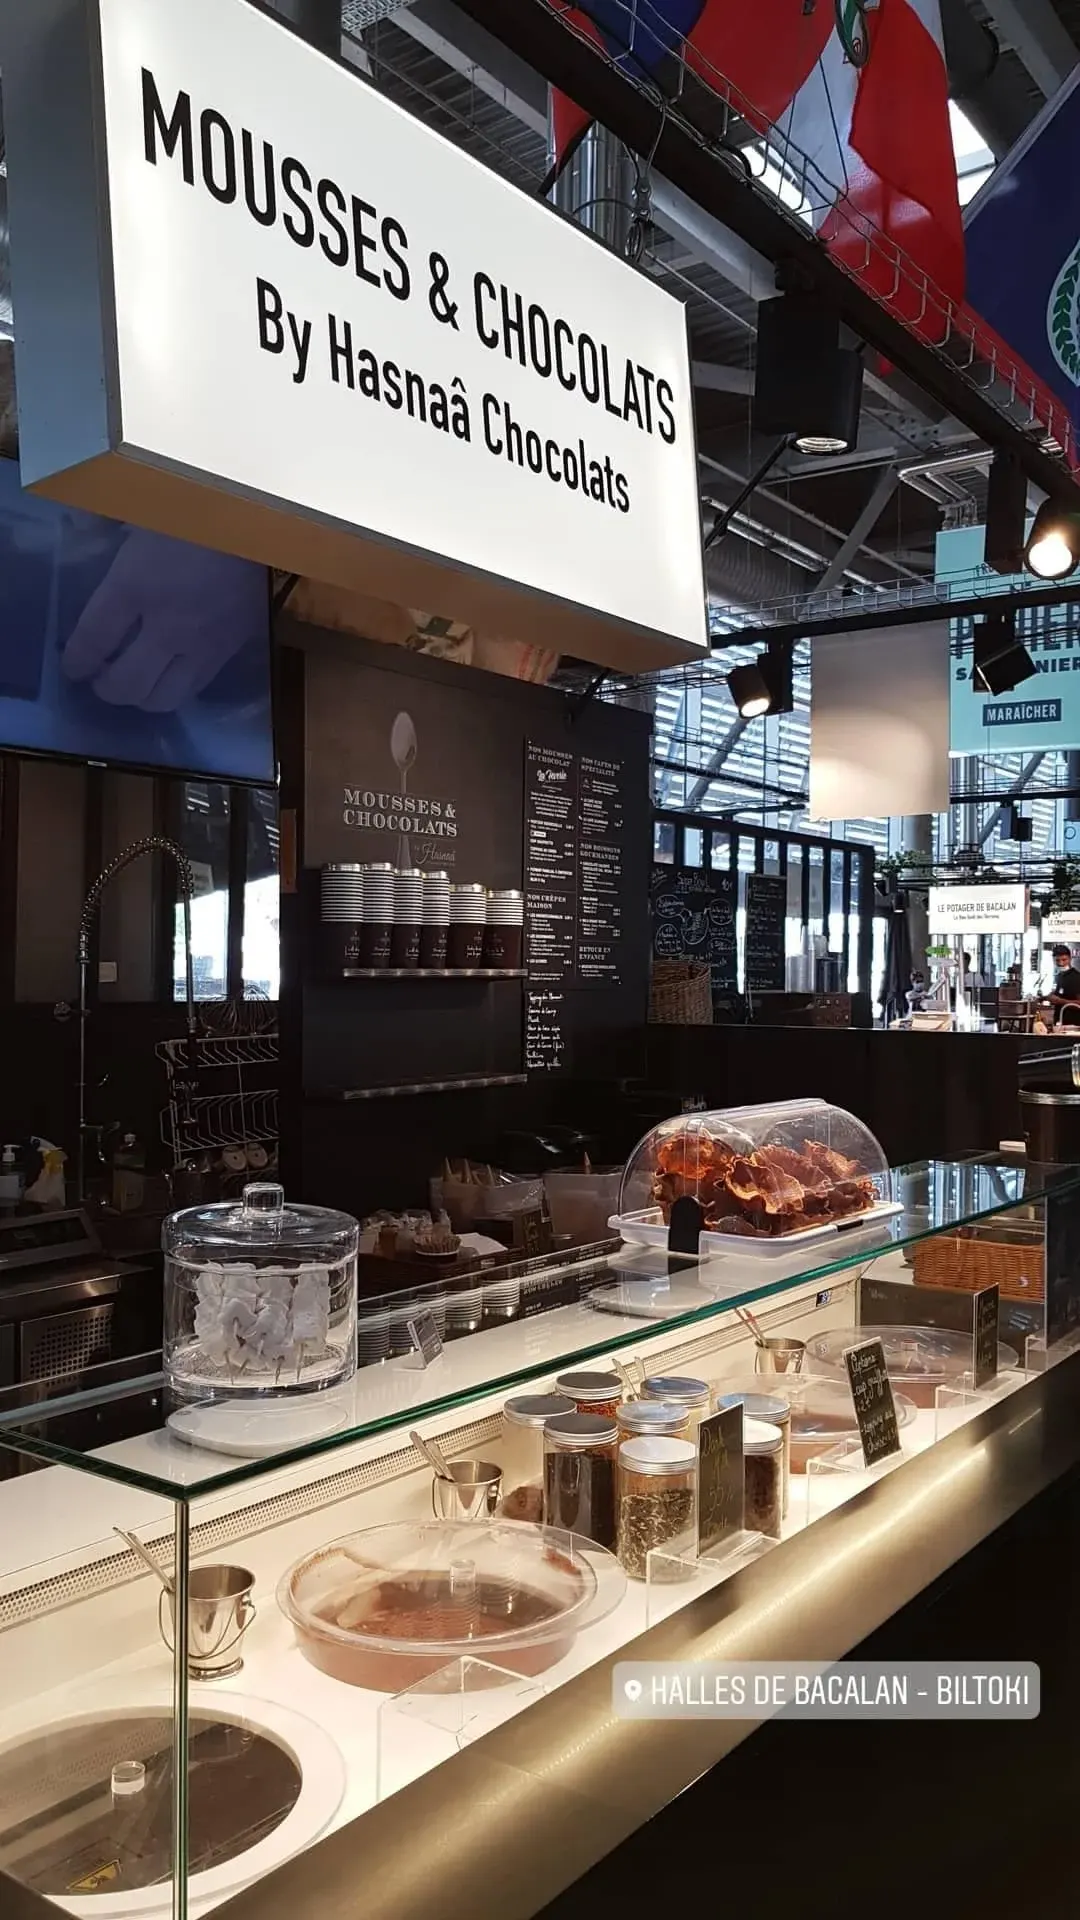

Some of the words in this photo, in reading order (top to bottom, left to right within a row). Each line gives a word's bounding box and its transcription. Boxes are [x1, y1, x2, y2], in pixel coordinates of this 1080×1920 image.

[140, 66, 411, 301] MOUSSES
[428, 252, 460, 330] &
[473, 271, 676, 444] CHOCOLATS
[256, 277, 312, 384] By
[328, 313, 471, 442] Hasnaâ
[482, 391, 630, 514] Chocolats
[343, 788, 441, 817] MOUSSES
[445, 803, 457, 819] &
[343, 809, 458, 838] CHOCOLATS
[937, 904, 946, 913] LE
[947, 903, 975, 912] POTAGER
[976, 903, 985, 912] DE
[986, 902, 1017, 912] BACALAN
